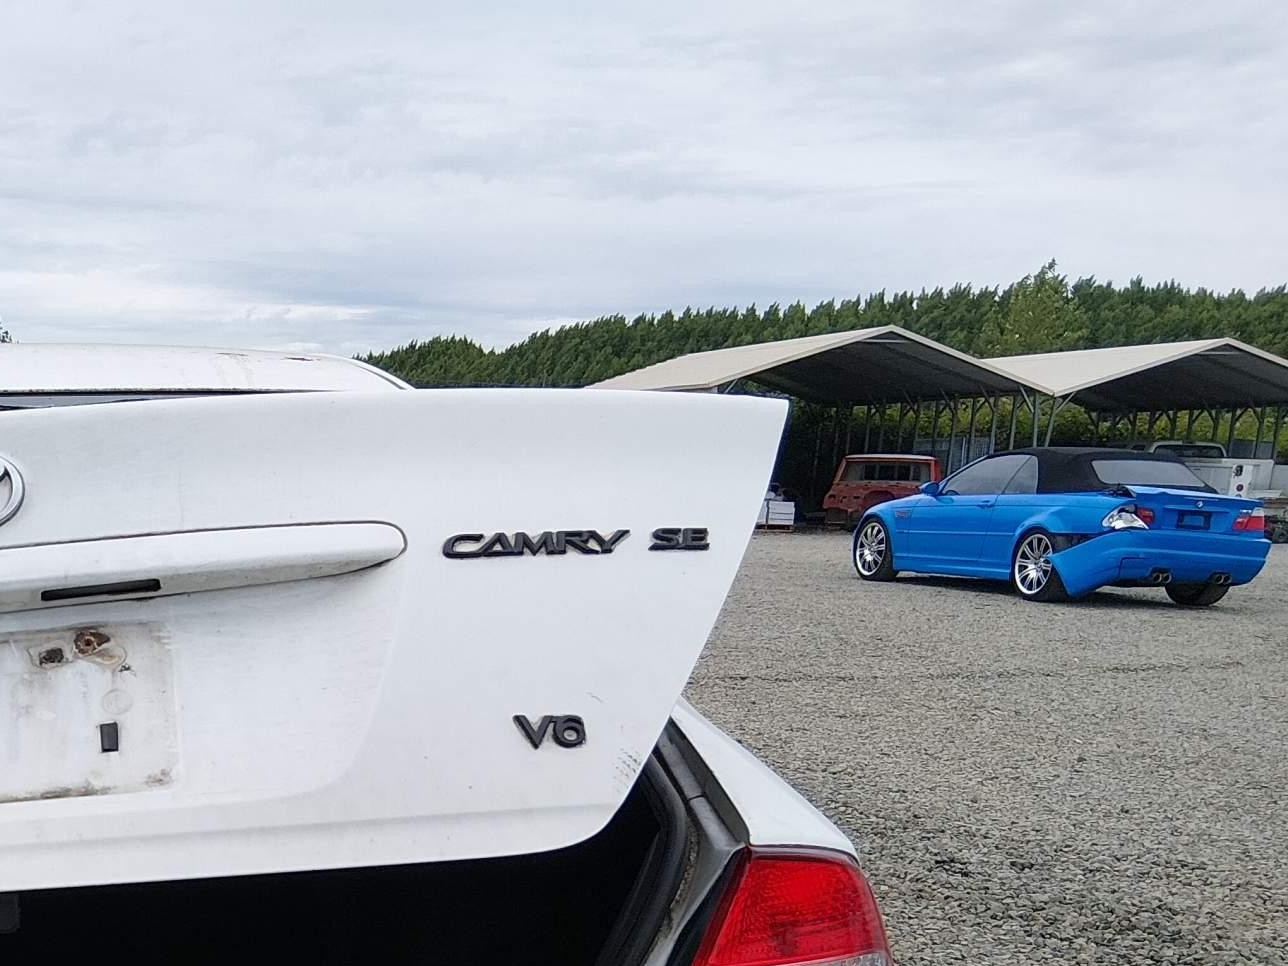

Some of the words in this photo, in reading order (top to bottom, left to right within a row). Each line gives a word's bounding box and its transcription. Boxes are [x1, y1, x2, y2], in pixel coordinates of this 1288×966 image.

[443, 529, 630, 559] CAMRY
[648, 527, 710, 551] SE
[513, 714, 587, 750] V6
